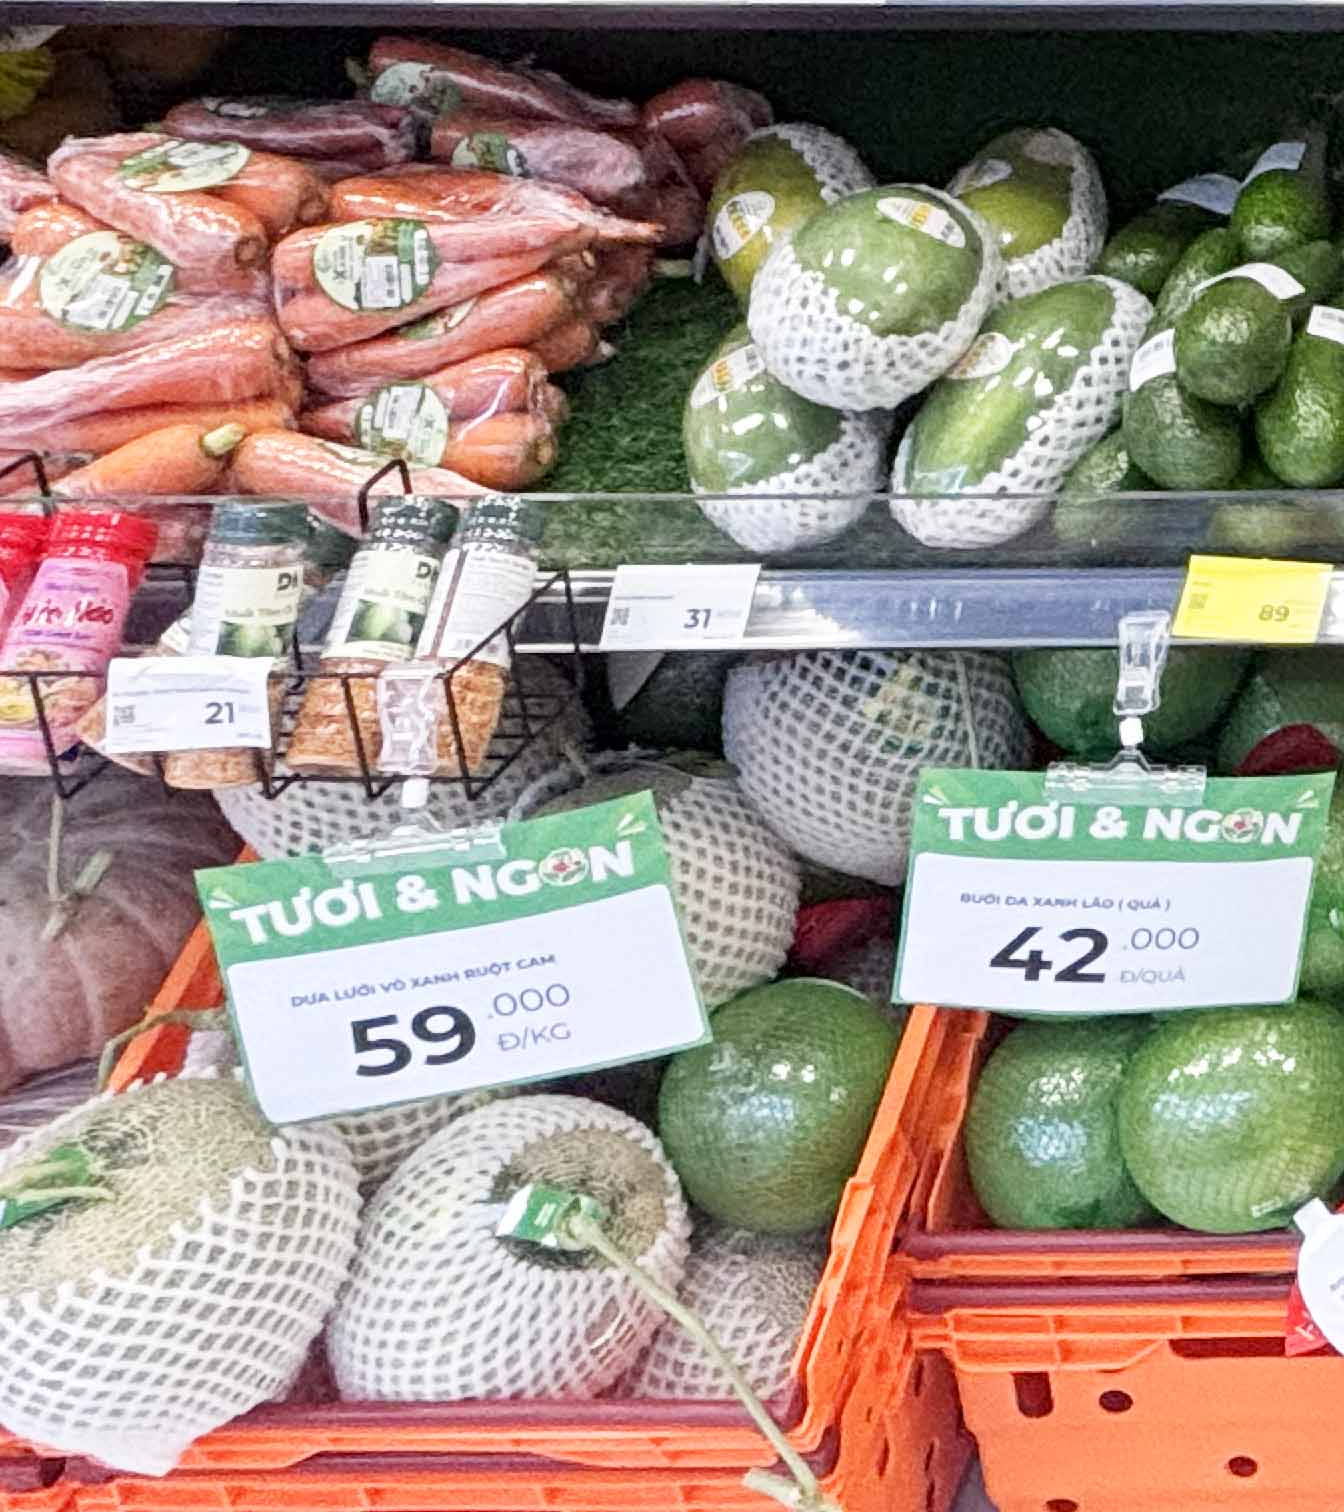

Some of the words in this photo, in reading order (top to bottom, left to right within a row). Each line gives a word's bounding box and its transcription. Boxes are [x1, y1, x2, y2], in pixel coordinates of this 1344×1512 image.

[683, 608, 712, 629] 31
[1258, 604, 1290, 623] 89
[204, 701, 235, 725] 21
[938, 799, 1076, 841] TƯƠI
[1088, 806, 1130, 841] &
[1142, 806, 1302, 846] NGON
[230, 879, 383, 945] TƯƠI
[395, 873, 439, 915] &
[451, 839, 636, 905] NGON
[1033, 896, 1079, 909] XANH
[411, 971, 459, 990] XANH
[516, 954, 557, 971] CAM
[988, 925, 1110, 984] 42
[350, 1004, 478, 1078] 59
